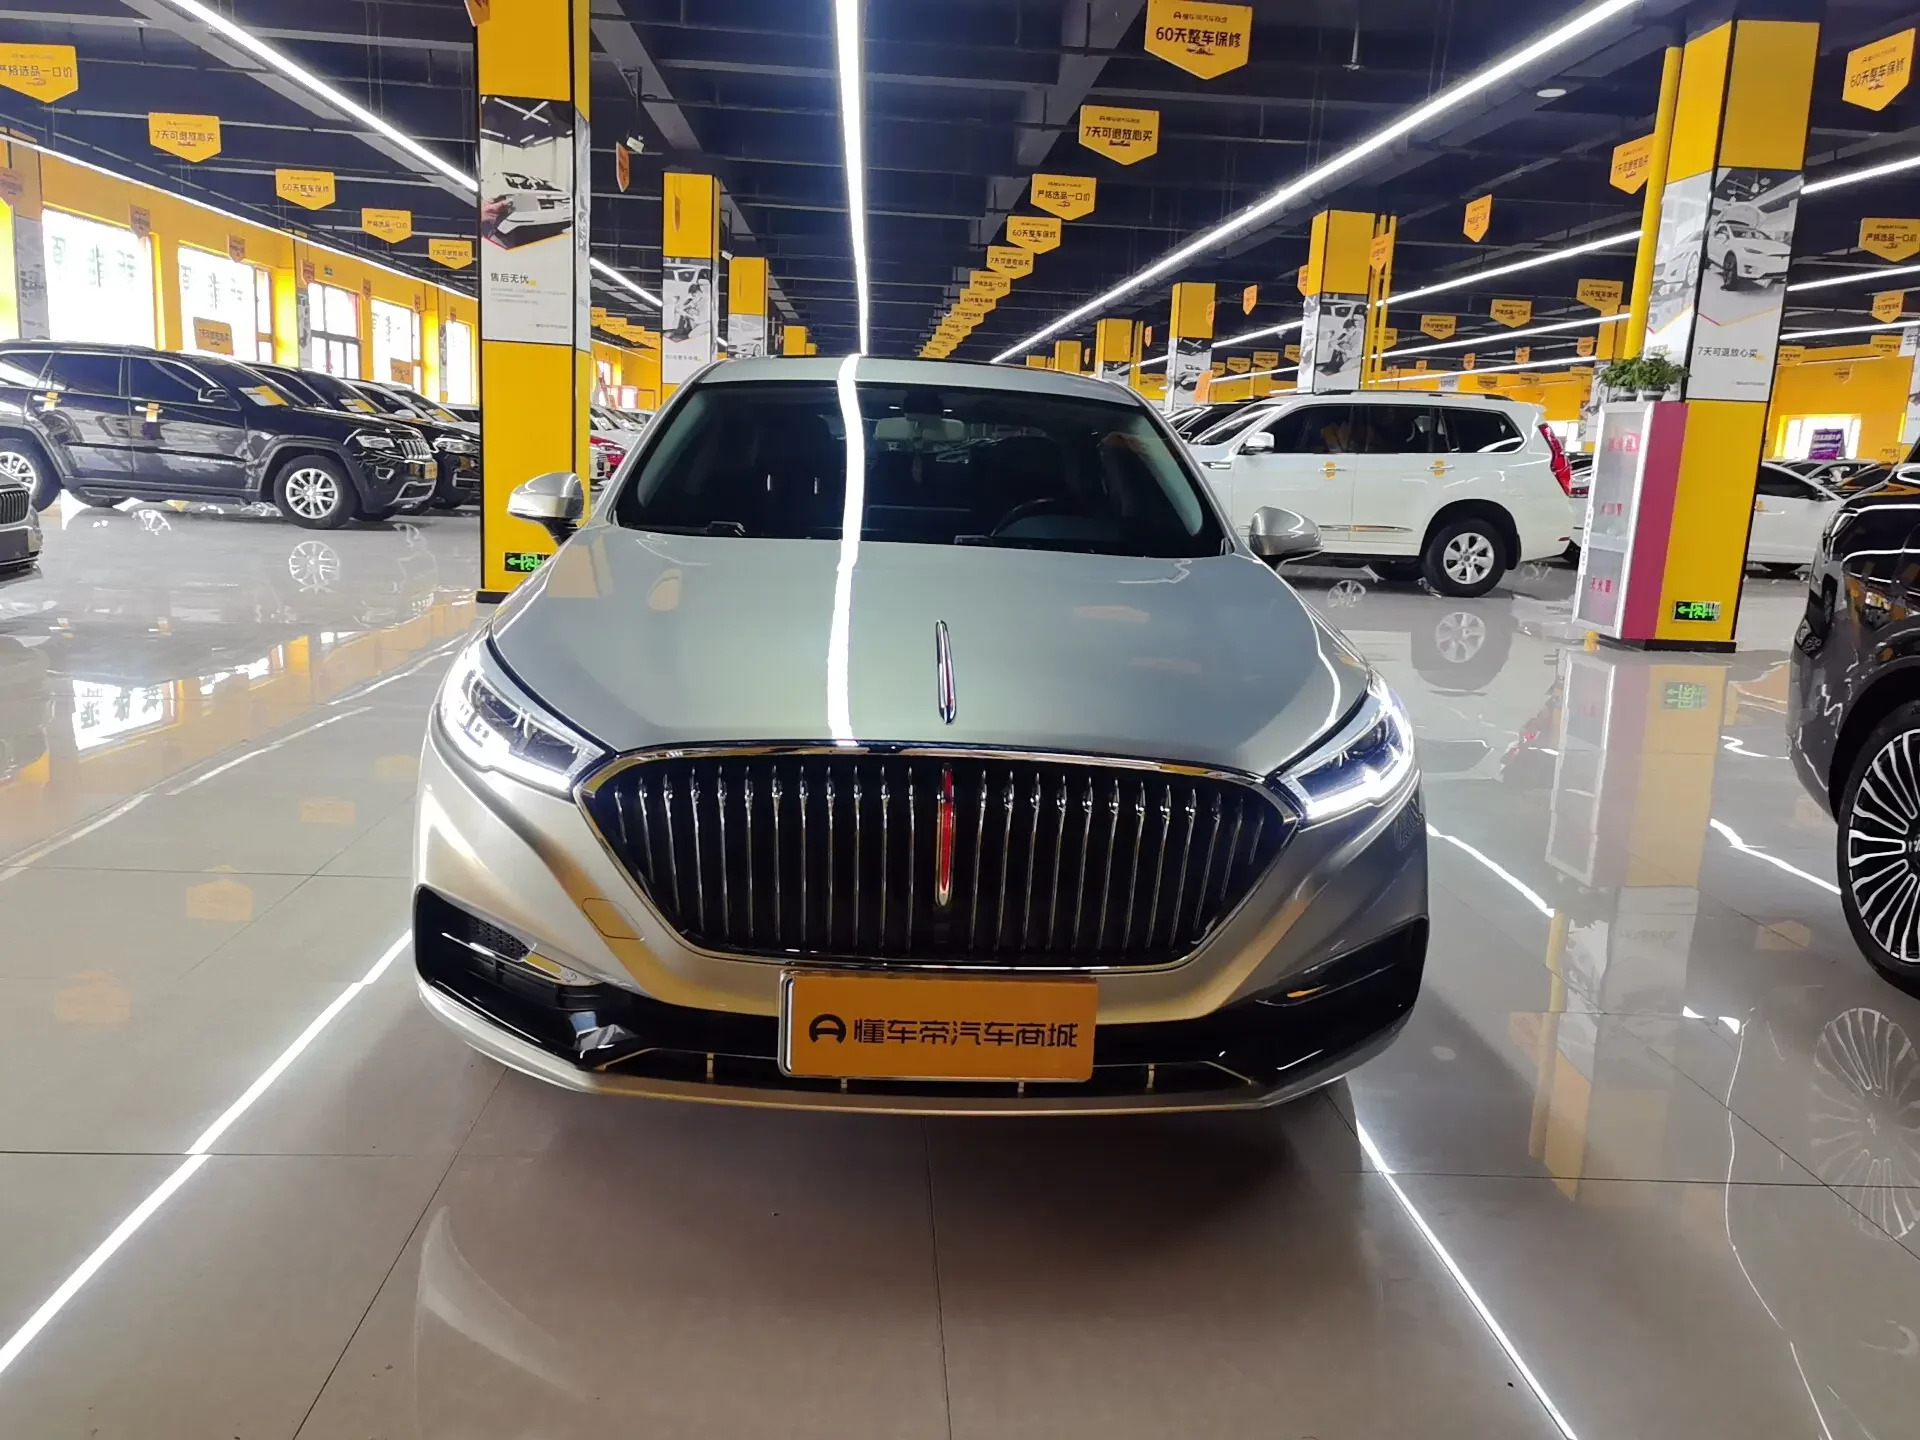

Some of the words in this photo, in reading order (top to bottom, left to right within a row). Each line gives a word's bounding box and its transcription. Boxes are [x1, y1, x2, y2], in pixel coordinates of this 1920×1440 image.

[1156, 27, 1241, 48] 60天整车保修
[1085, 126, 1153, 141] 7天可退放心买
[1037, 190, 1091, 202] 严格选品一口价
[491, 273, 529, 284] 售后无忧
[1697, 346, 1758, 358] 7天可退放心买
[854, 1017, 1079, 1048] 懂车帝汽车商城
